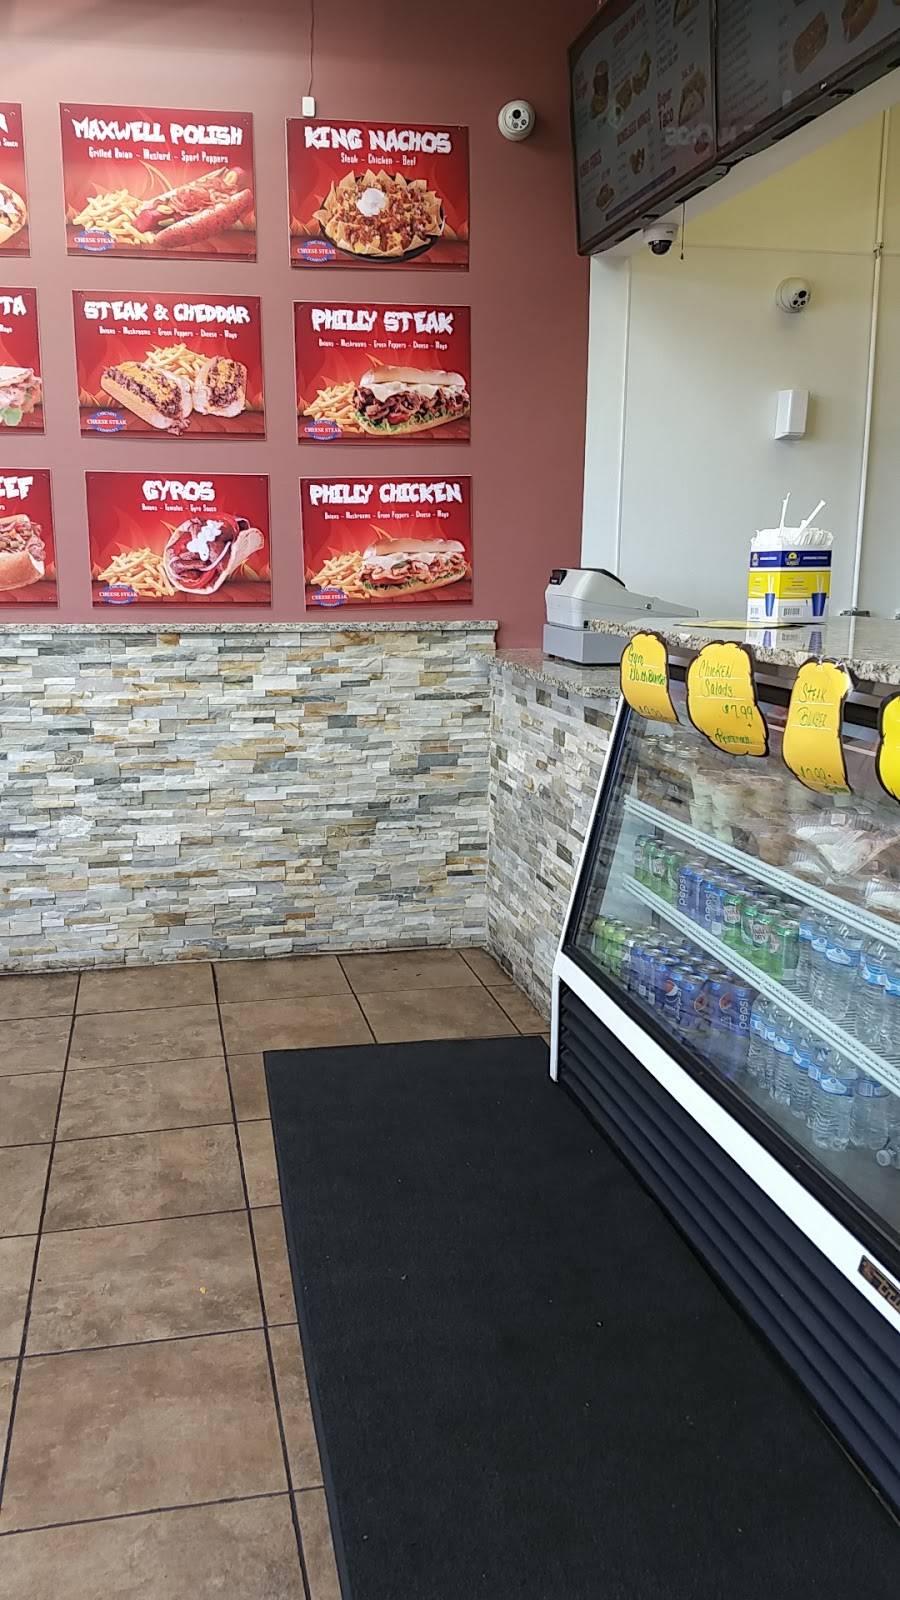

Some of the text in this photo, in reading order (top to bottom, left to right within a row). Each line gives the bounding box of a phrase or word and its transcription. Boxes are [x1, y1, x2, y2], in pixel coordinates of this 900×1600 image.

[72, 117, 243, 145] MAXWELL POLISH
[304, 126, 452, 154] KING NACHOS
[88, 146, 112, 159] Grilled
[143, 148, 171, 161] Mustard
[181, 150, 199, 163] Sport
[202, 151, 229, 164] Peppers
[341, 152, 417, 166] Steak Chicken Beef
[84, 300, 250, 324] STEAK & CHEDDAR
[311, 308, 453, 335] PHILLY STEAK
[173, 328, 193, 338] Peppers
[318, 338, 334, 347] Onions
[340, 338, 367, 348] Mushrooms
[373, 340, 387, 348] Green
[388, 340, 407, 350] Peppers
[413, 341, 429, 349] Cheese
[142, 480, 216, 501] GYROS
[309, 481, 463, 506] PHILLY CHICKEN
[324, 511, 339, 520] Onions
[345, 511, 371, 520] Mushrooms
[377, 510, 390, 519] Green
[391, 510, 410, 520] Peppers
[415, 510, 431, 519] Cheese
[678, 875, 688, 906] pepsi
[739, 997, 750, 1030] pepsi
